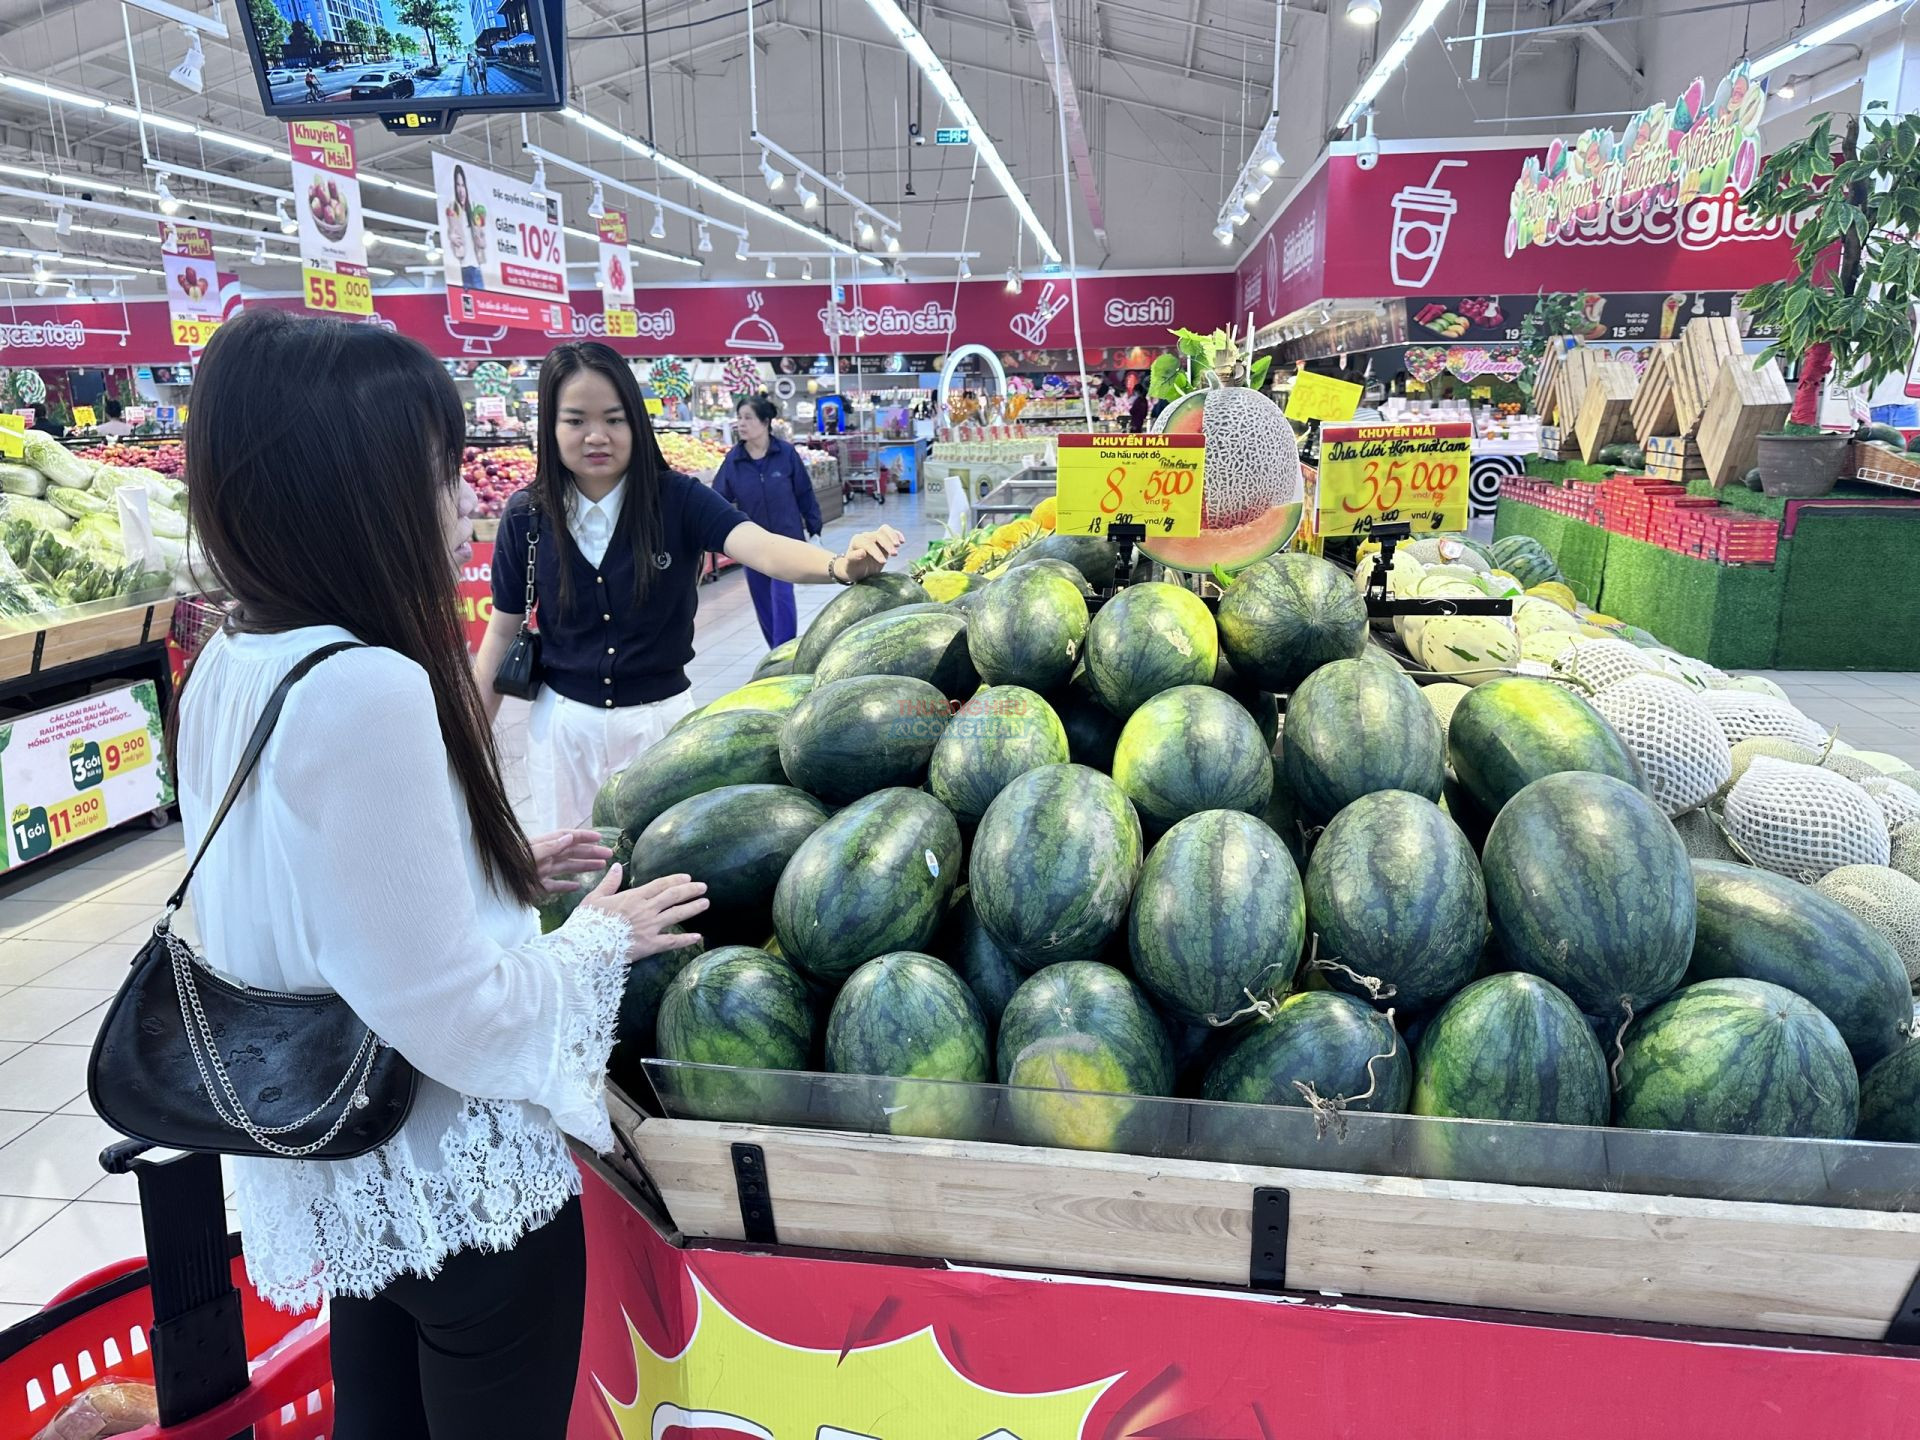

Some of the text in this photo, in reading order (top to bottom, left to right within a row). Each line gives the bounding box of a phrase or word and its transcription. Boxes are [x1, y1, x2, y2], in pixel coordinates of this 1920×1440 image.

[294, 123, 336, 143] Khuyến
[327, 145, 350, 168] Mãi!
[496, 217, 561, 265] Giảm 10%
[310, 277, 369, 309] 55 .000
[881, 308, 909, 332] ăn
[913, 304, 953, 332] sẵn
[1107, 299, 1171, 324] Sushi
[47, 321, 82, 347] loại
[177, 325, 199, 344] 29
[1505, 328, 1520, 340] 19
[1612, 326, 1627, 338] 15
[1754, 324, 1773, 336] 35
[1462, 349, 1524, 374] Vitamin
[1092, 433, 1170, 447] KHUYẾN MÃI
[1358, 424, 1436, 439] KHUYẾN MÃI
[1100, 449, 1161, 461] Dưa hấu ruột đỏ
[1100, 466, 1127, 514] 8
[1342, 460, 1406, 514] 35
[1087, 516, 1102, 534] 18
[82, 705, 97, 714] RAU
[39, 727, 55, 737] RAU
[84, 714, 99, 723] RAU
[65, 728, 81, 738] RAU
[105, 736, 145, 771] 9 .900
[71, 755, 101, 782] 3 GÓI
[50, 797, 99, 838] 11 .900
[14, 823, 46, 850] 1 GÓI
